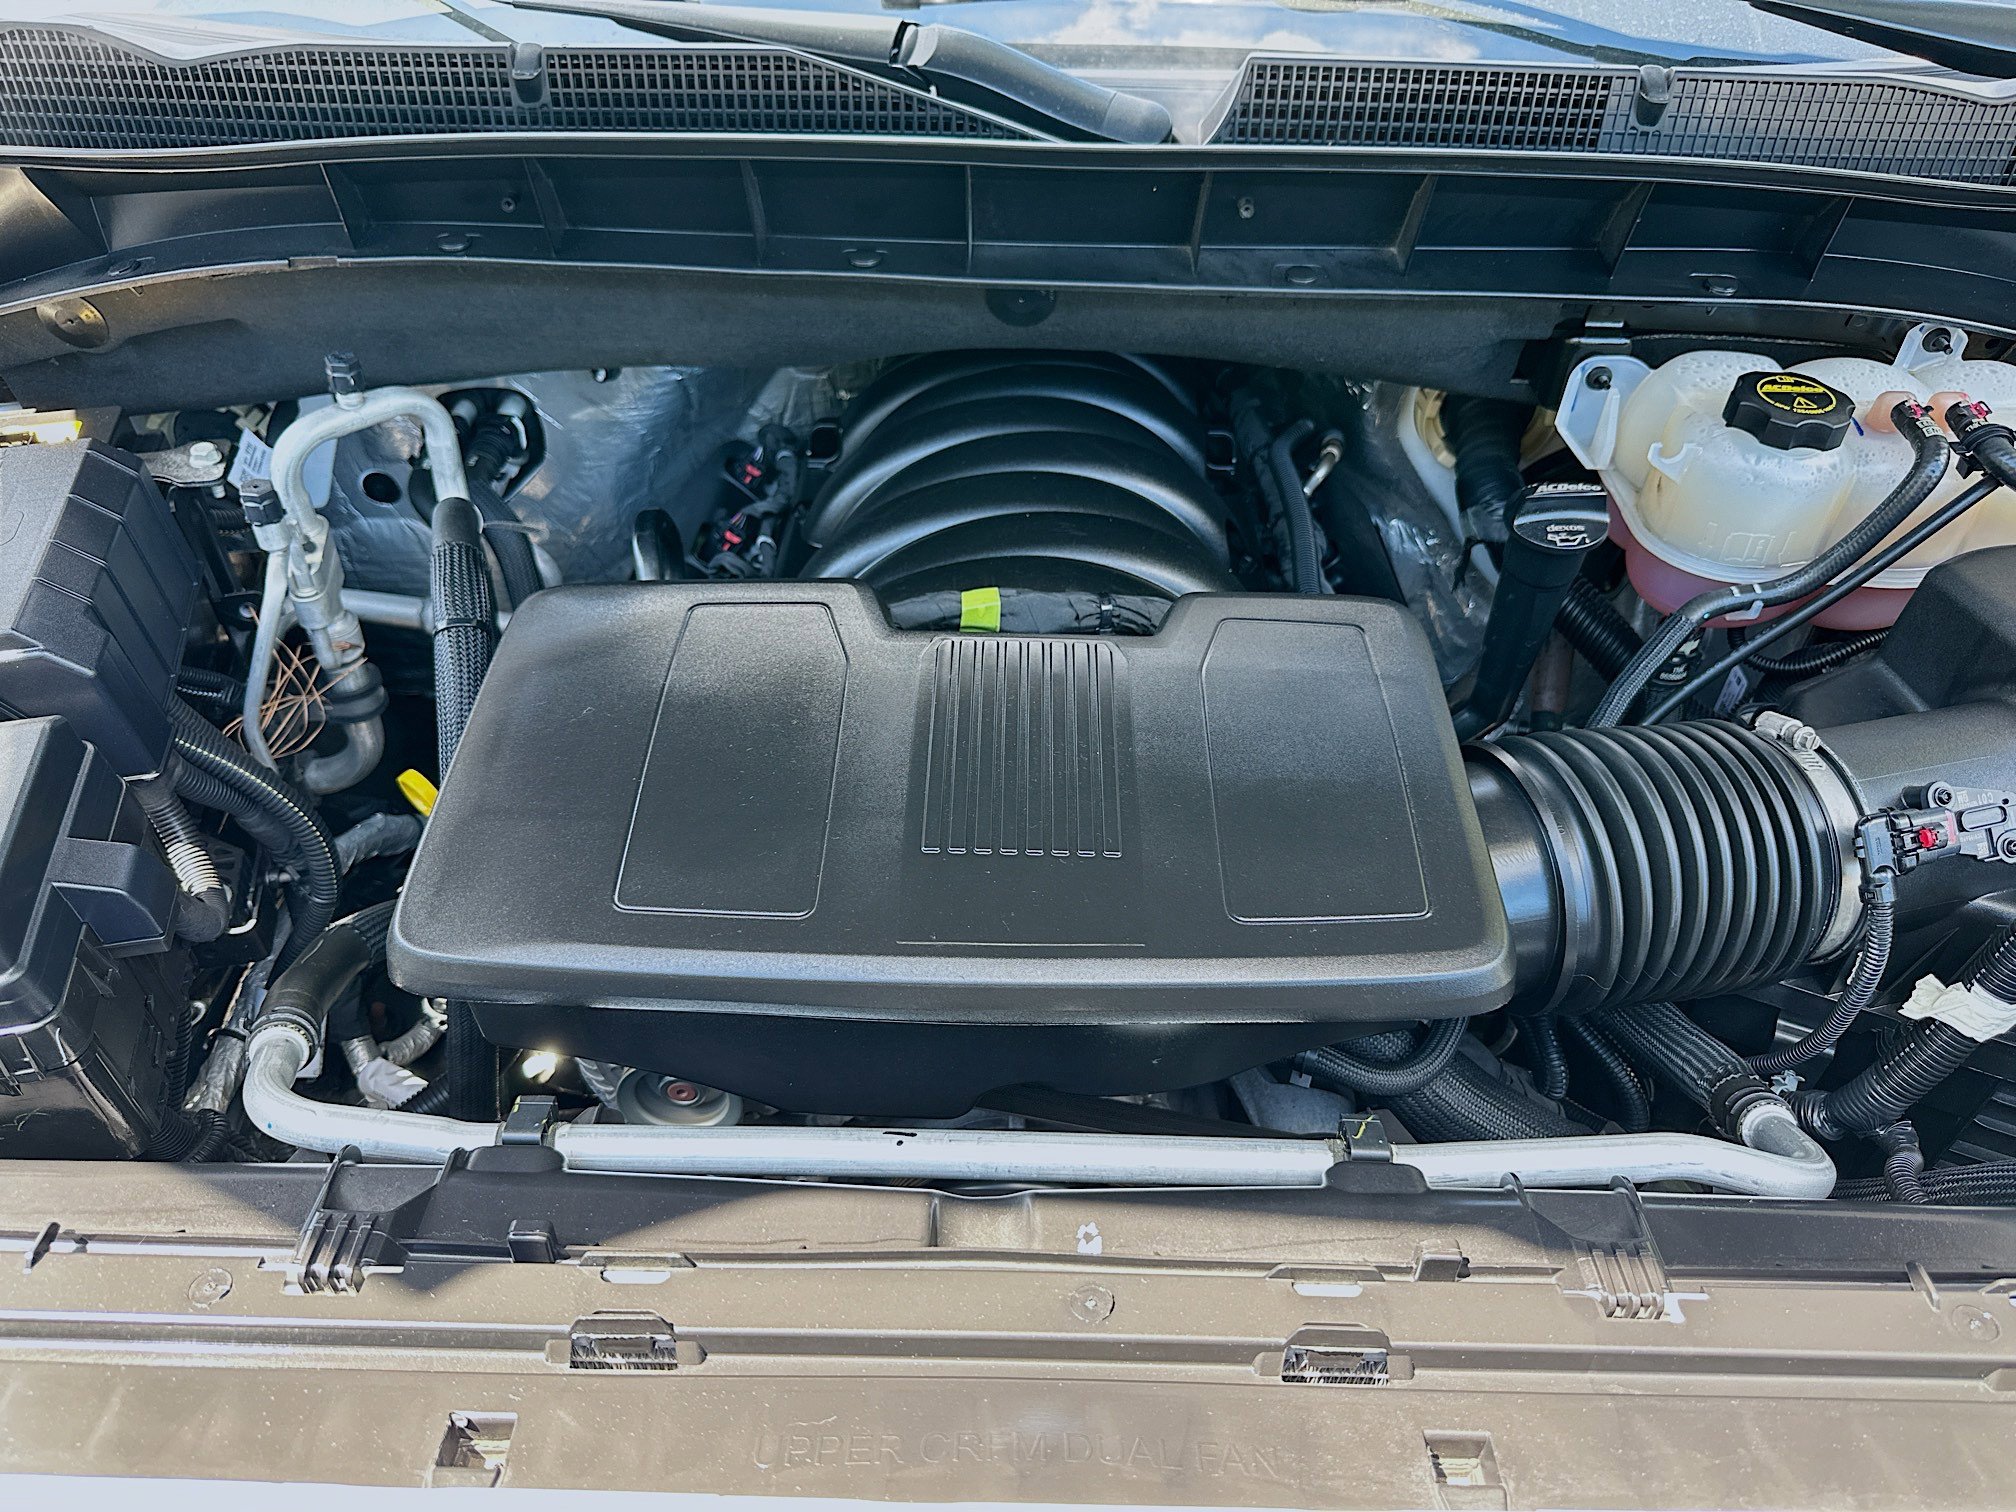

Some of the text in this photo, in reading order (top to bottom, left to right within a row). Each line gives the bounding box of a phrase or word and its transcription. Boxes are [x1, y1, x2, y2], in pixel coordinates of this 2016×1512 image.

[1761, 383, 1824, 392] ACDelco
[1536, 483, 1602, 493] ACDelco
[1546, 524, 1586, 533] dexos
[753, 1432, 904, 1469] UPPER
[1064, 1432, 1183, 1470] DUAL
[1194, 1440, 1282, 1478] FAN
